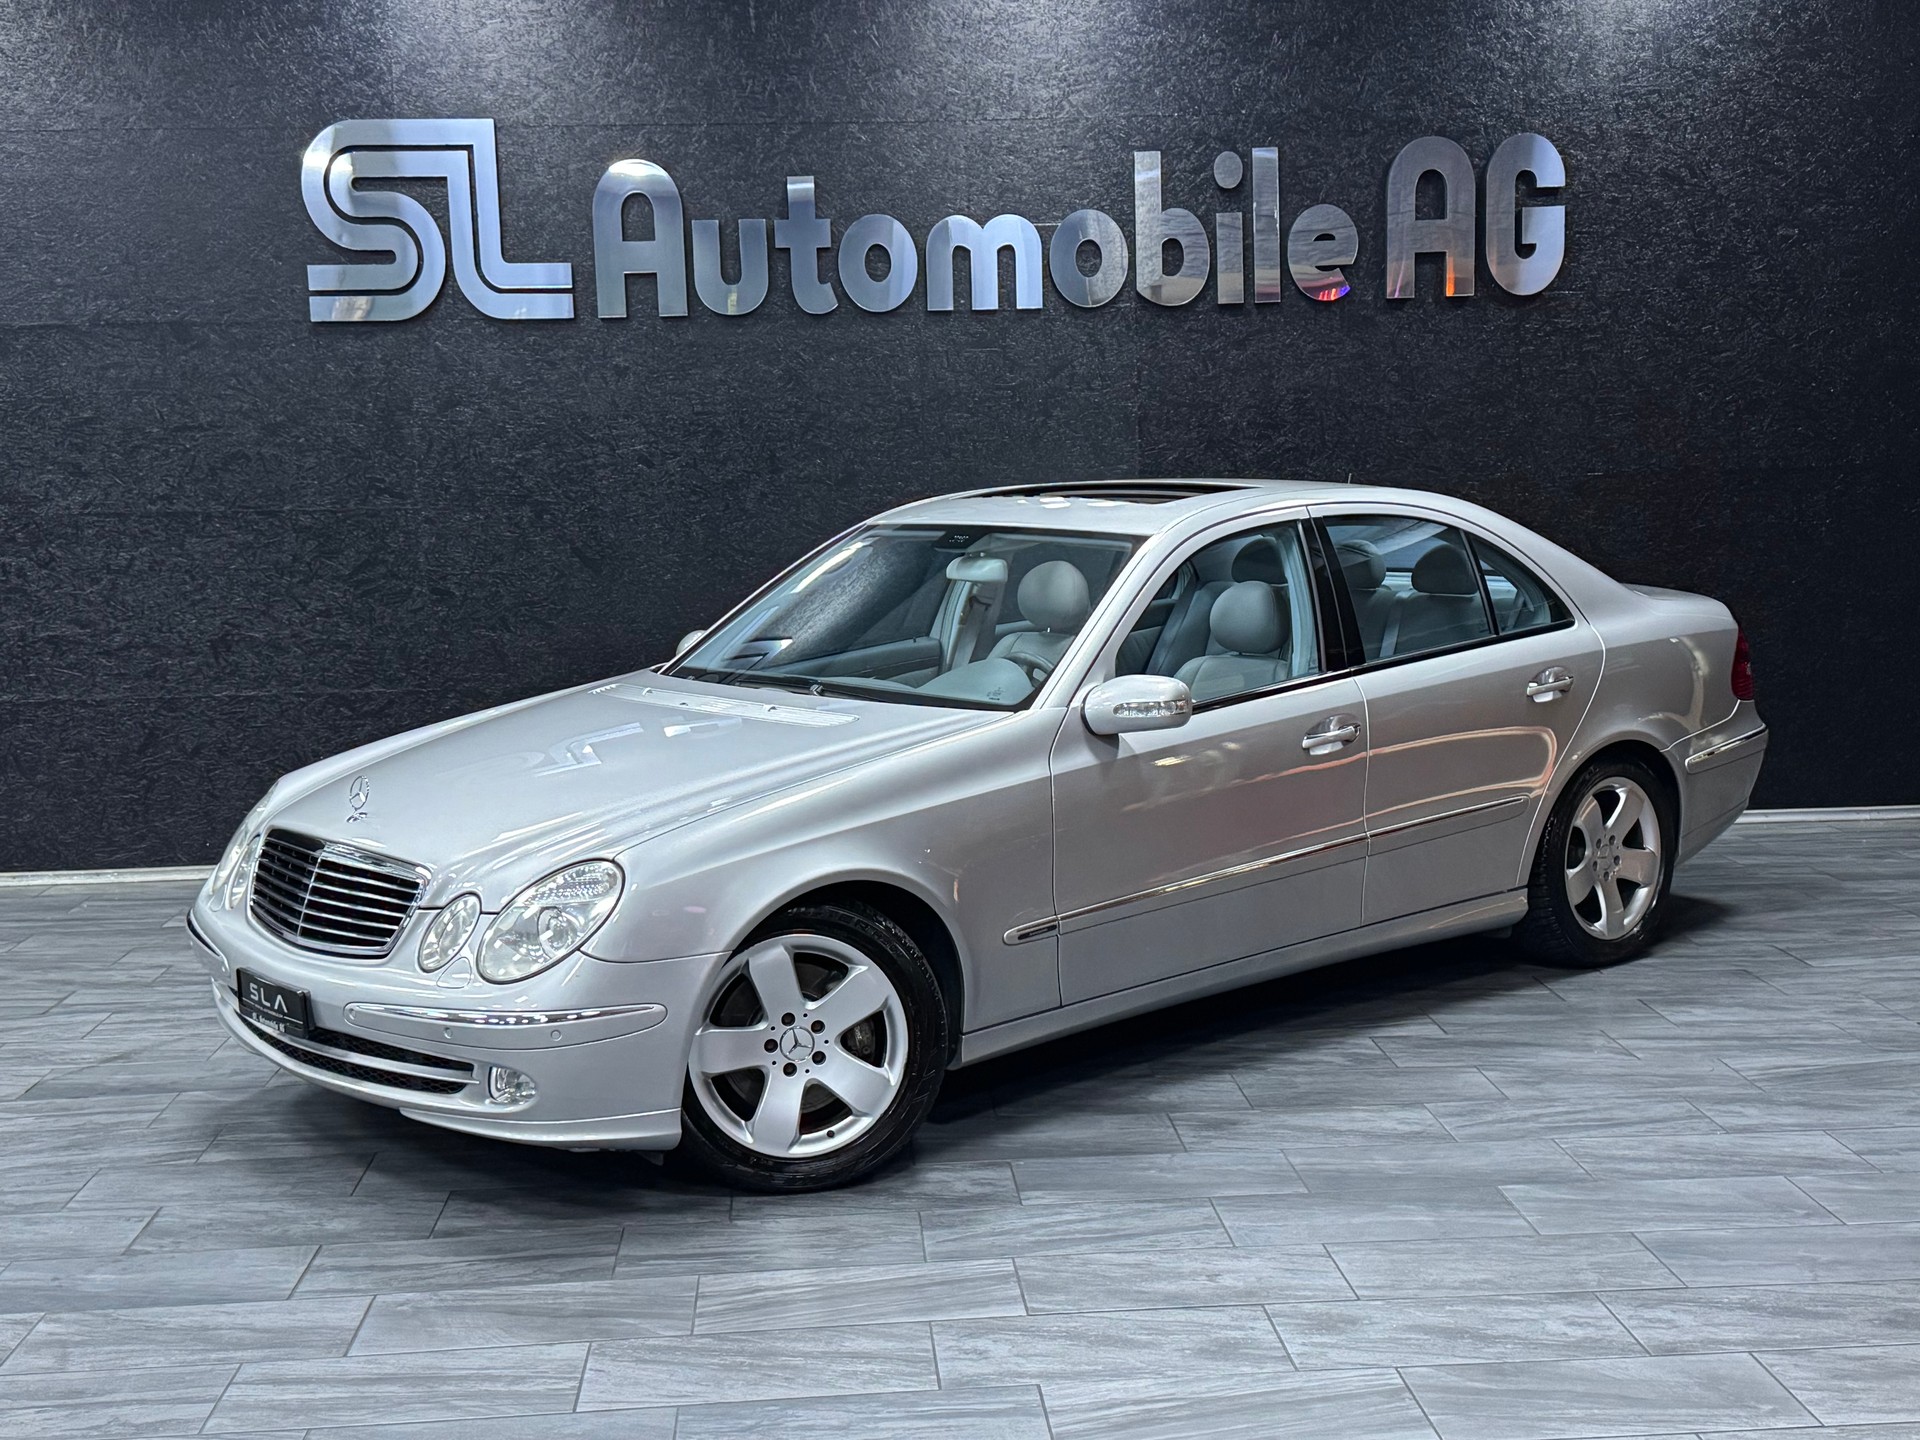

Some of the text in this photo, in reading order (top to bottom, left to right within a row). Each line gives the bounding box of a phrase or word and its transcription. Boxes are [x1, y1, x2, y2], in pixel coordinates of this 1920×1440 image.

[300, 118, 1566, 322] SL Automobile AG
